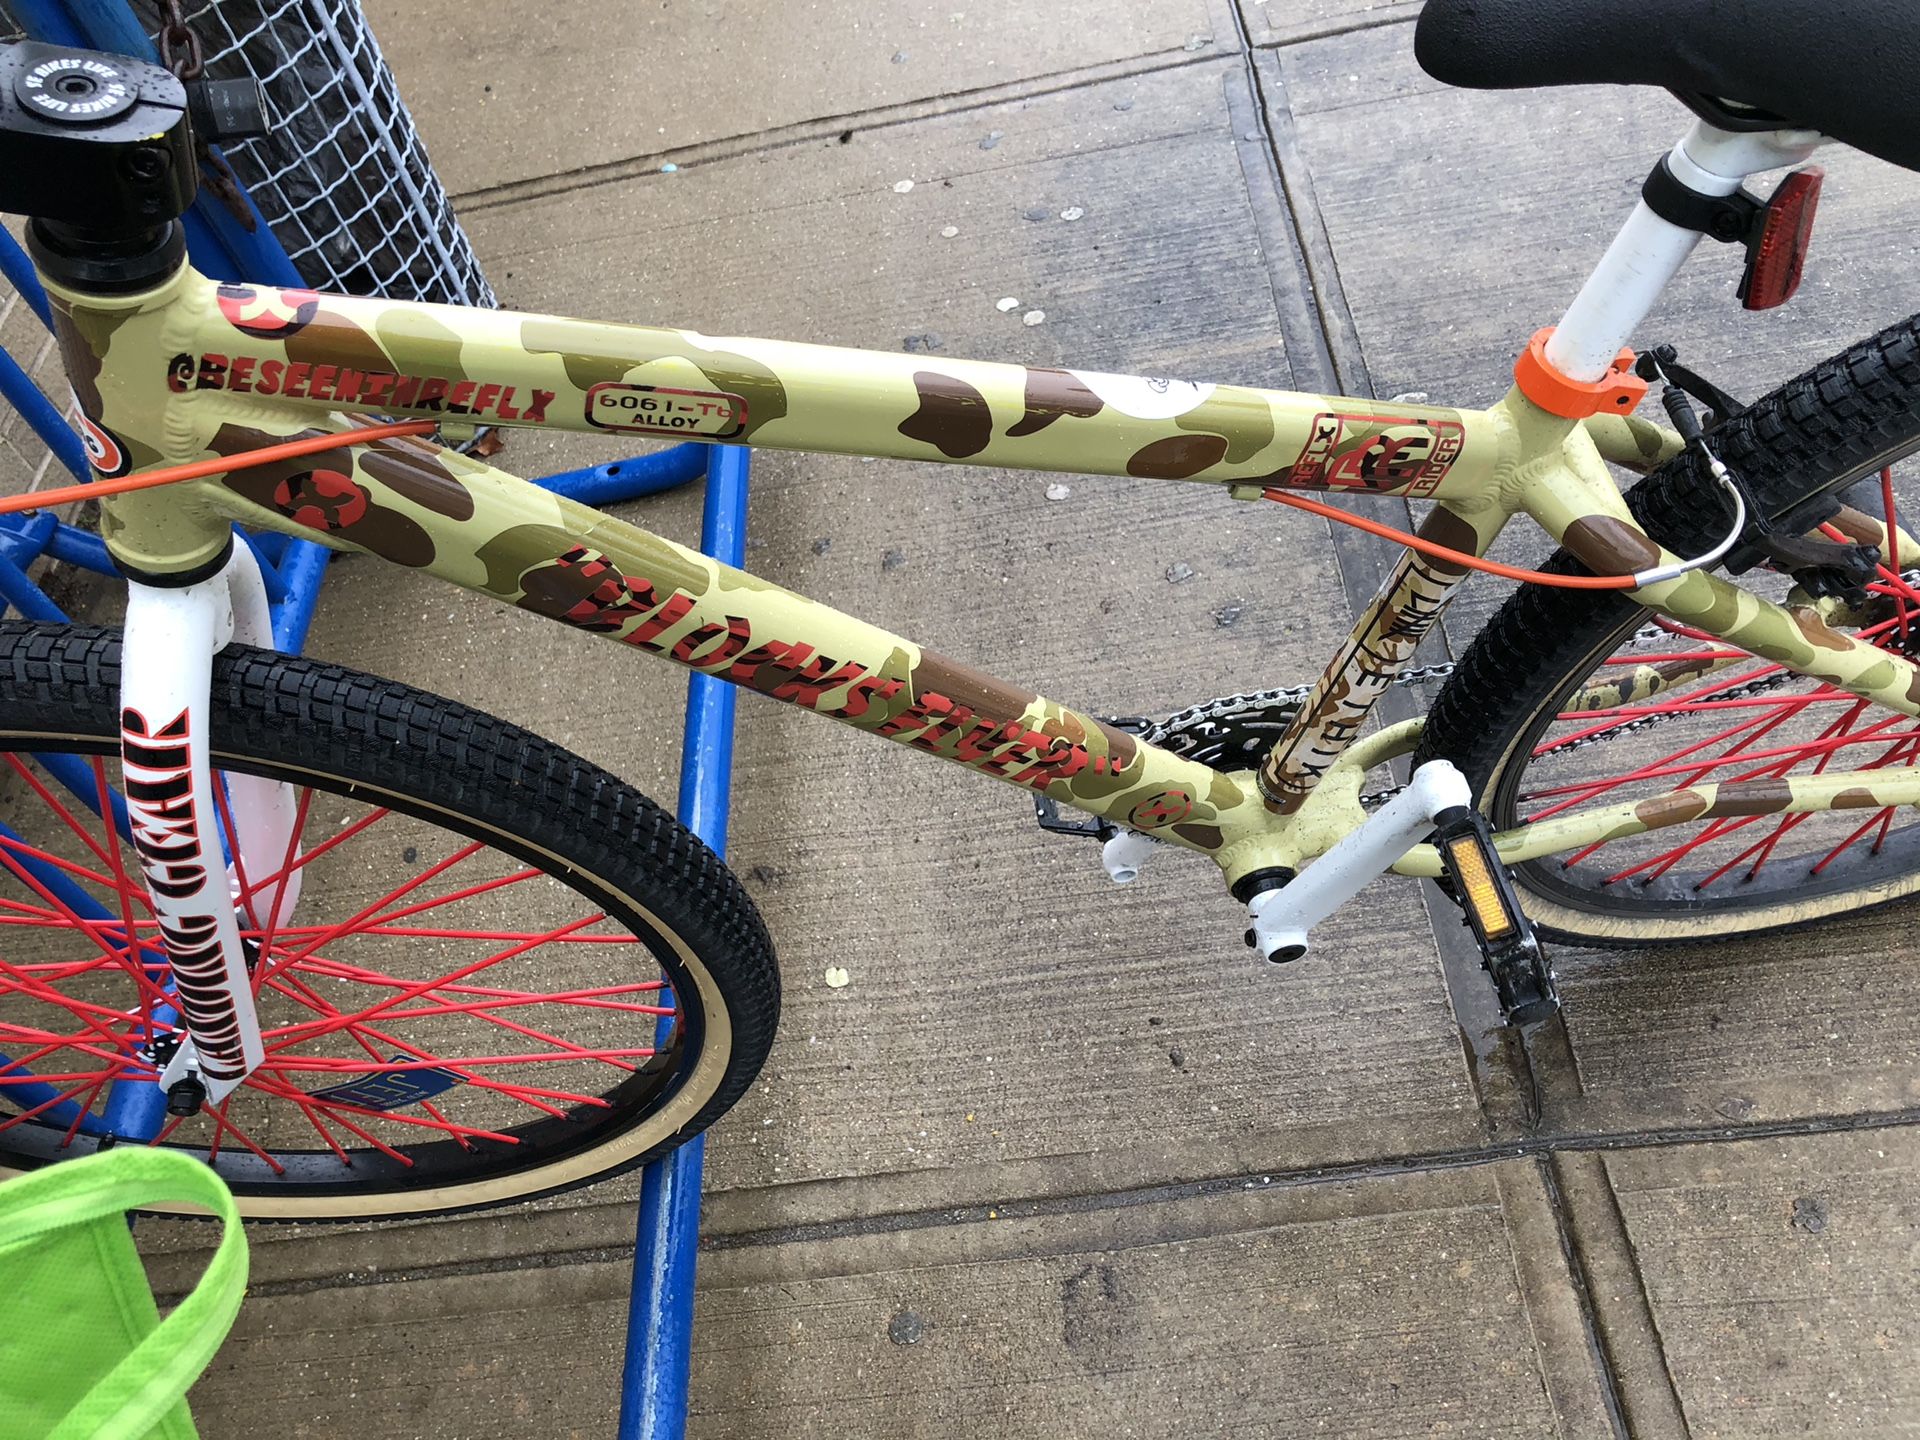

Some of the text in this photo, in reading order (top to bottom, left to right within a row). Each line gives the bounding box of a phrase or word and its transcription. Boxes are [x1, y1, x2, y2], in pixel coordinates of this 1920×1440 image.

[25, 59, 118, 88] SE BIKES LIFE
[32, 84, 126, 113] SE BIKES LIFE
[600, 394, 734, 418] 6061-T6
[631, 413, 700, 429] ALLOY
[1413, 438, 1459, 491] RIDER
[1294, 670, 1396, 779] ETHIK
[122, 707, 206, 898] GEAR
